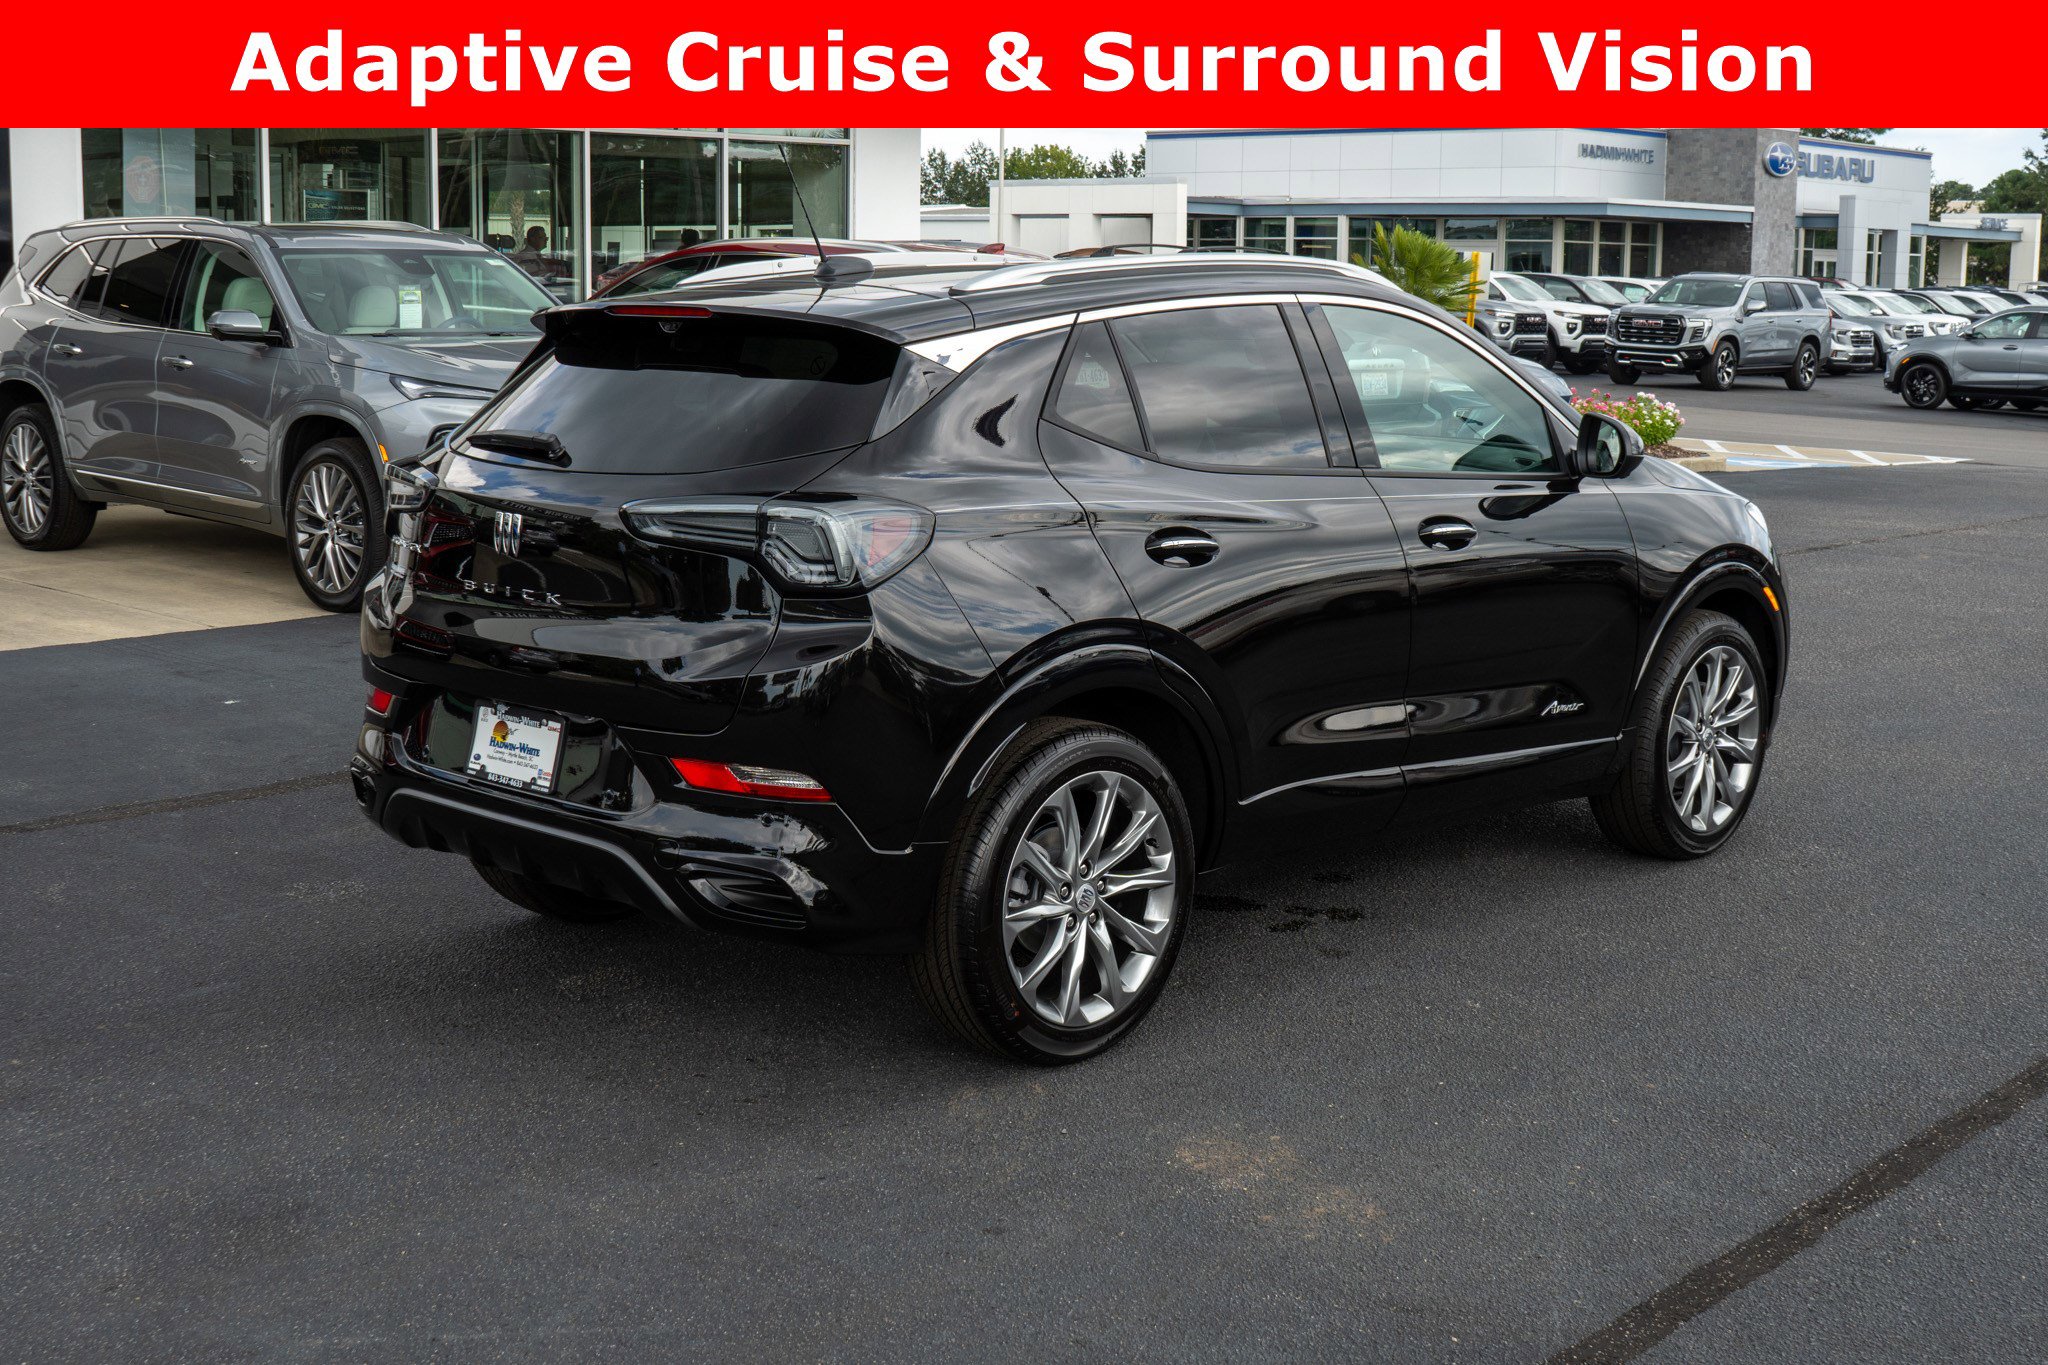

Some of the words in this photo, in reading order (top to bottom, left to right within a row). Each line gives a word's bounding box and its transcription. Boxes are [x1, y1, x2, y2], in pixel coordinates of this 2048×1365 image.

[1797, 151, 1875, 183] SUBARU
[1632, 318, 1663, 328] GMC
[464, 579, 562, 606] BUICK
